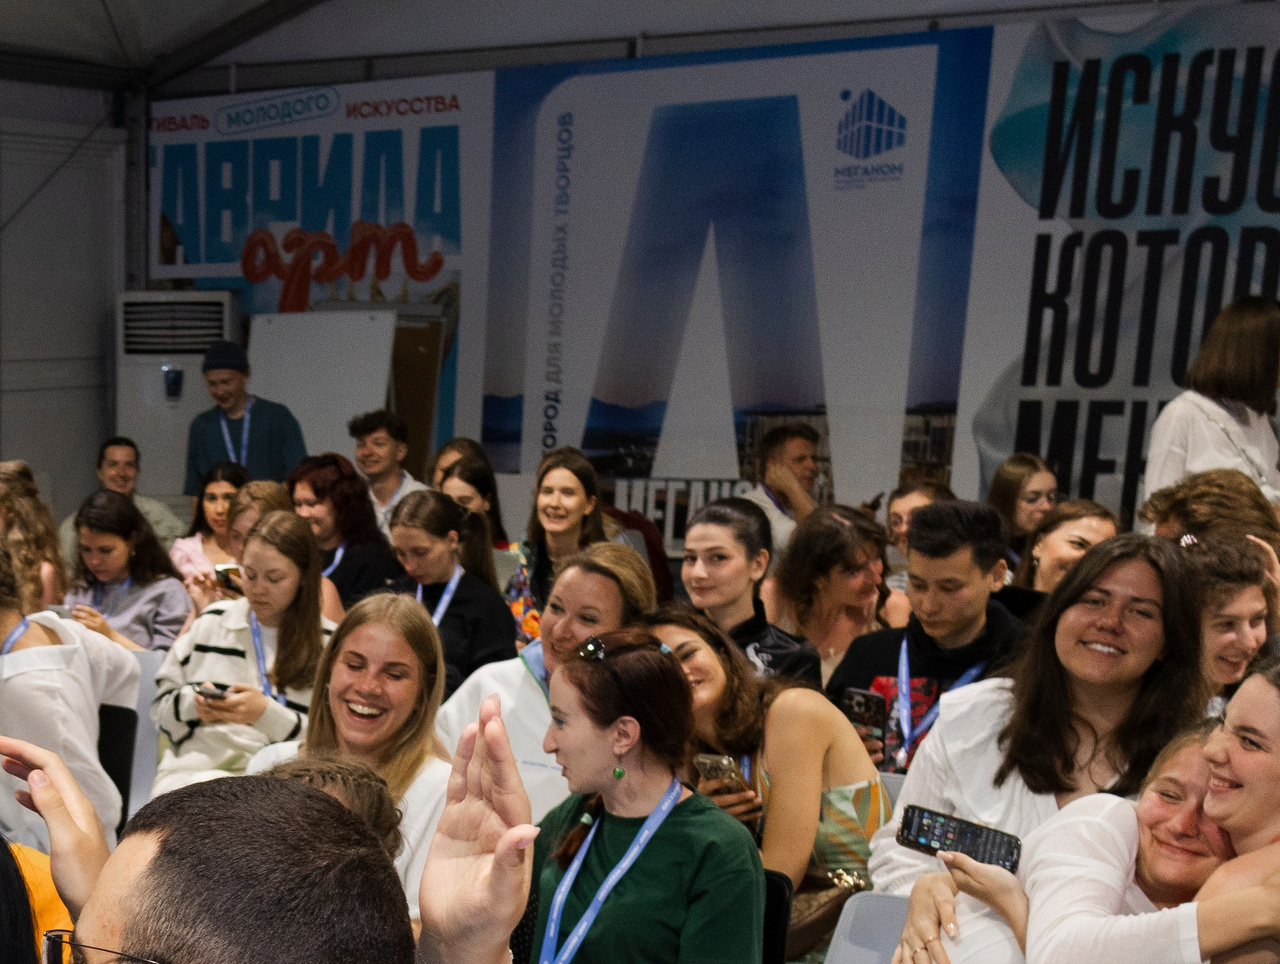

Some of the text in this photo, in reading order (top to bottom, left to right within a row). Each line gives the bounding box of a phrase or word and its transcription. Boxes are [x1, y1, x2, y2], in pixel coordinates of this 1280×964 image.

[226, 95, 329, 127] МОЛОДОГО
[345, 94, 461, 119] ИСКУССТВА
[151, 126, 463, 266] АВРИДА
[555, 111, 574, 220] ТВОРЦОВ
[549, 226, 568, 336] МОЛОДЫХ
